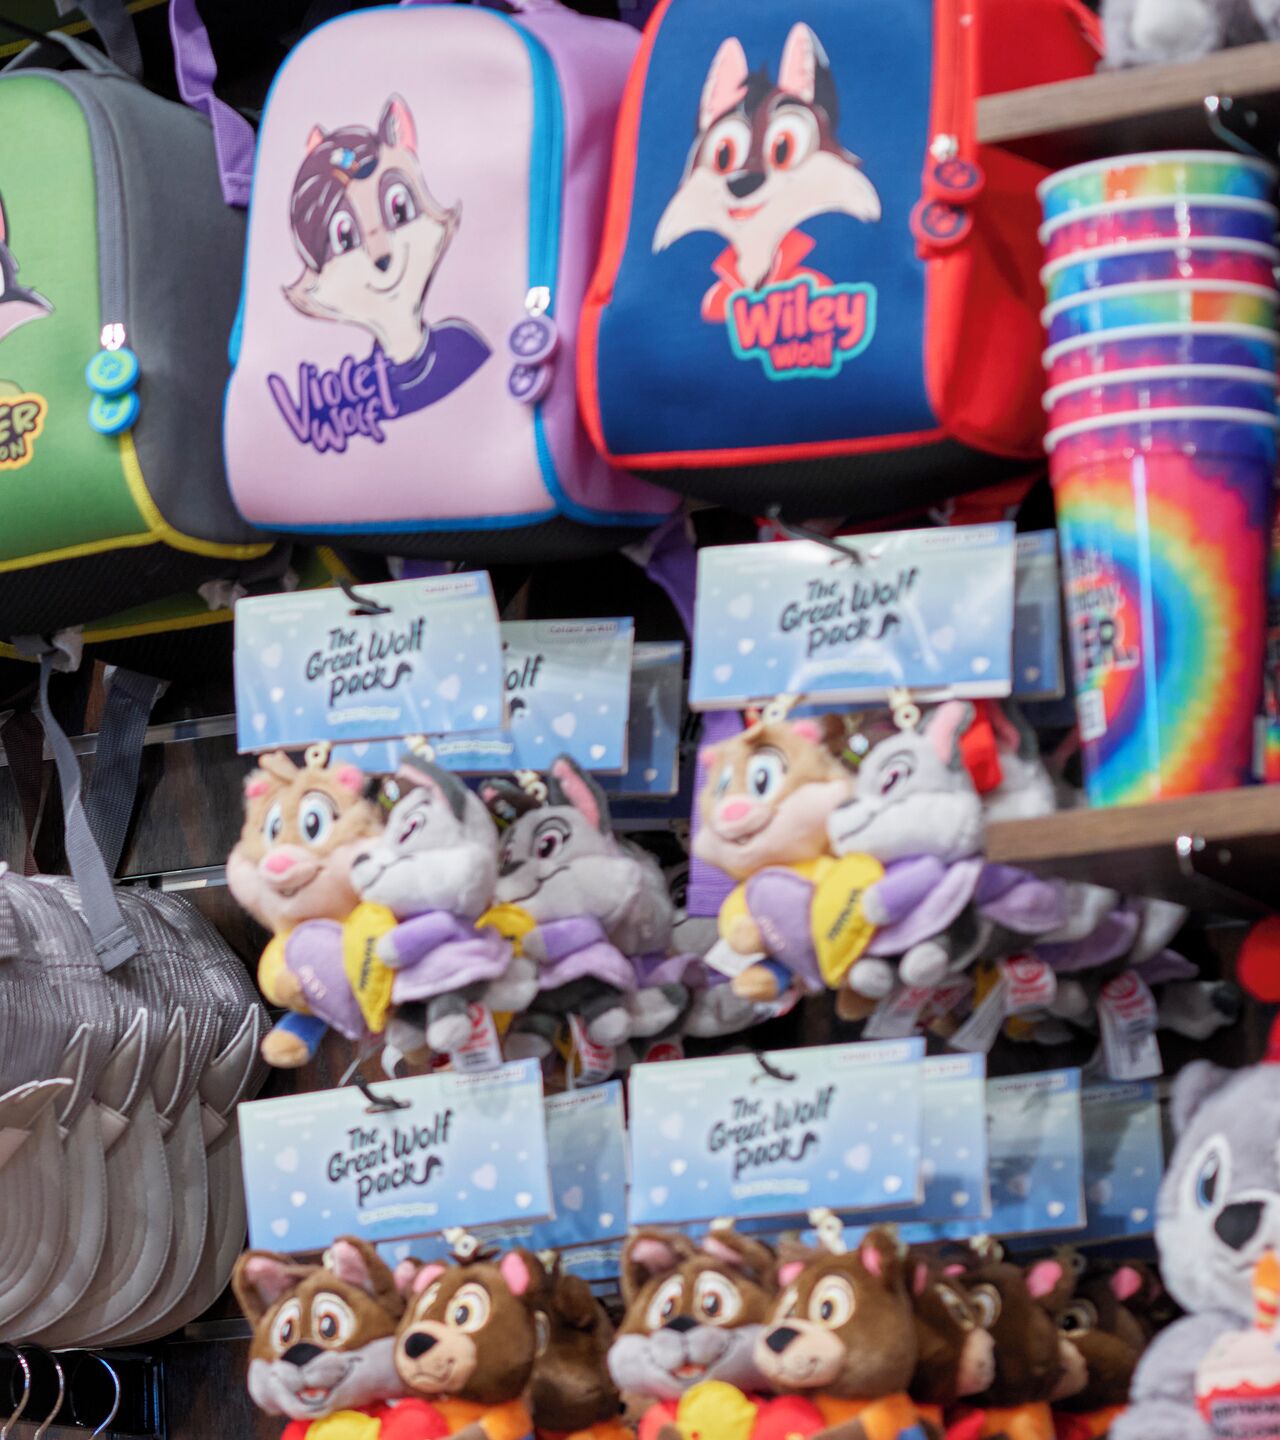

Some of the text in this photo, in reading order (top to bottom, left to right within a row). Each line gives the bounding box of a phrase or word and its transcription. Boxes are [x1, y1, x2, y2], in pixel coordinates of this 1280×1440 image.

[733, 283, 866, 349] Wiley
[269, 351, 400, 442] Violet
[780, 567, 920, 633] Great Wolf
[807, 579, 837, 600] The
[306, 616, 427, 682] Great Wolf
[328, 627, 356, 655] The
[506, 655, 543, 692] olf
[348, 1127, 378, 1150] The
[709, 1084, 836, 1153] Great Wolf
[733, 1096, 761, 1119] The
[328, 1107, 452, 1183] Great Wolf
